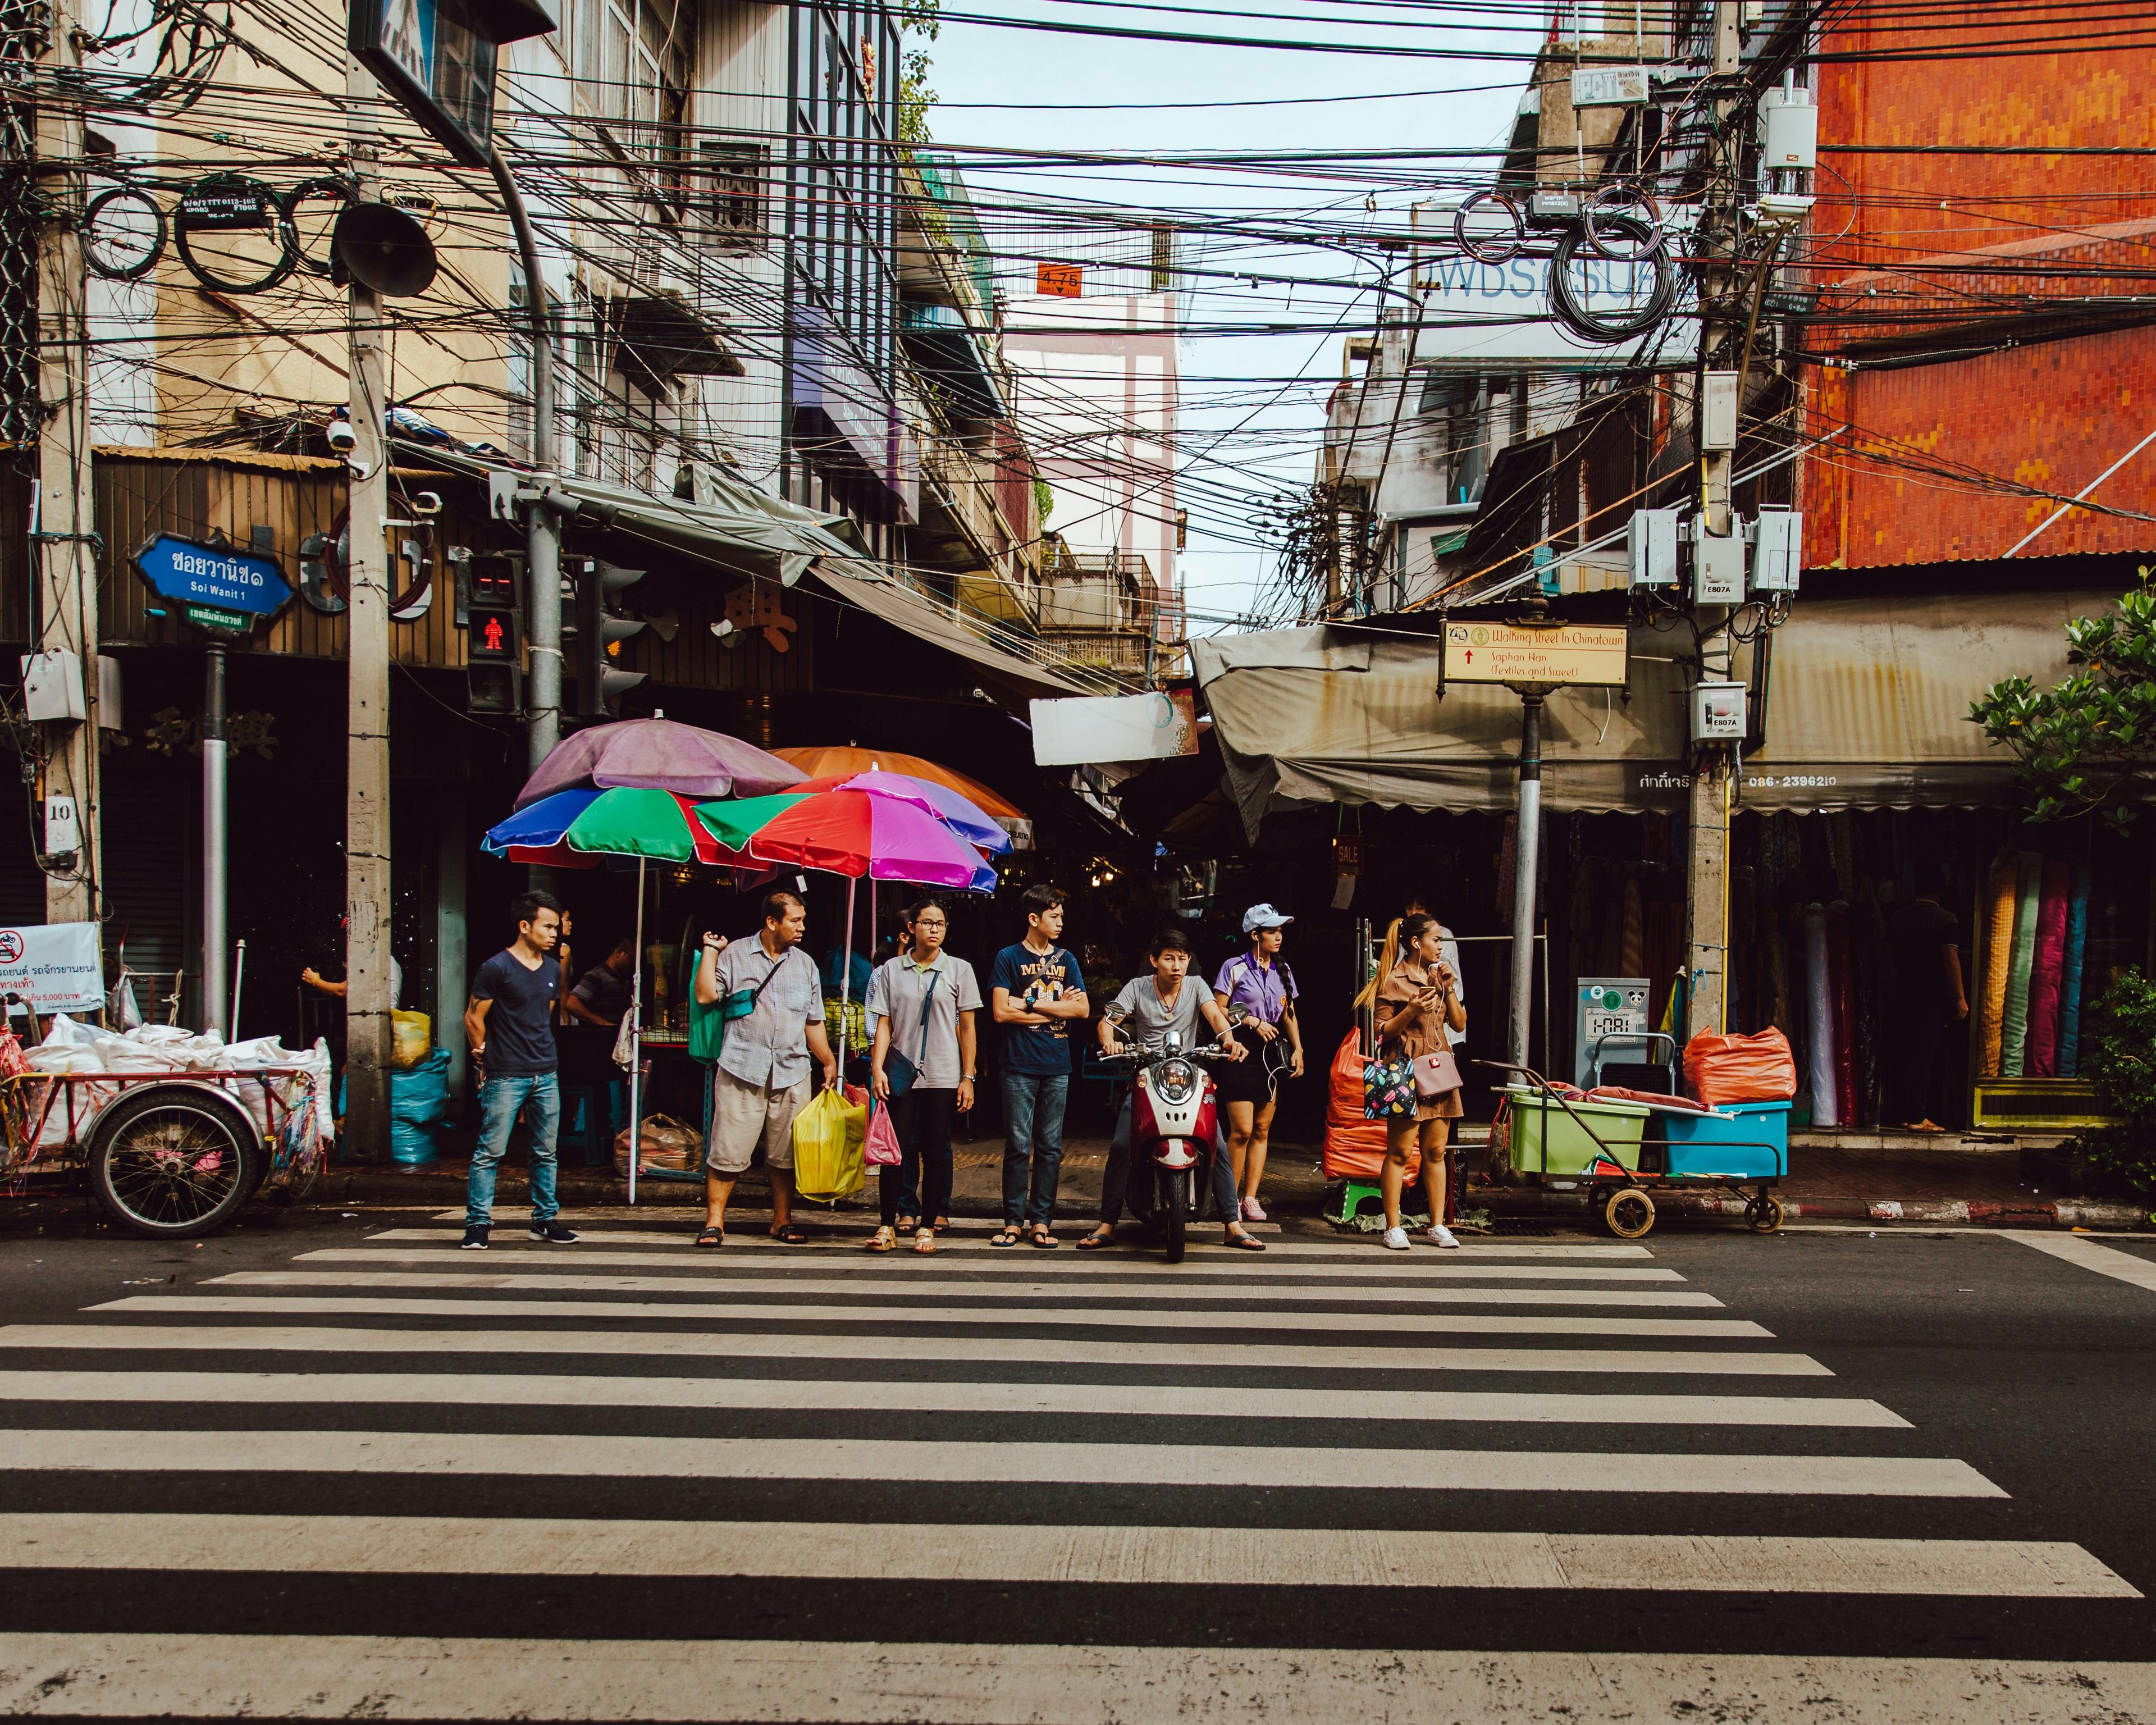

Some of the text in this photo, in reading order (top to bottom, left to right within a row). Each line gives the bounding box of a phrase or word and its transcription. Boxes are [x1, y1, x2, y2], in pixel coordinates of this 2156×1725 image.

[1042, 271, 1078, 287] 4.75
[191, 581, 245, 600] Soi Wanit 1
[1492, 629, 1623, 646] Walking Street In Chinatown
[1491, 651, 1547, 664] Saphan Han
[1491, 665, 1578, 677] (Textiles and Sweet)
[49, 805, 71, 820] 10
[1338, 846, 1358, 863] SALE
